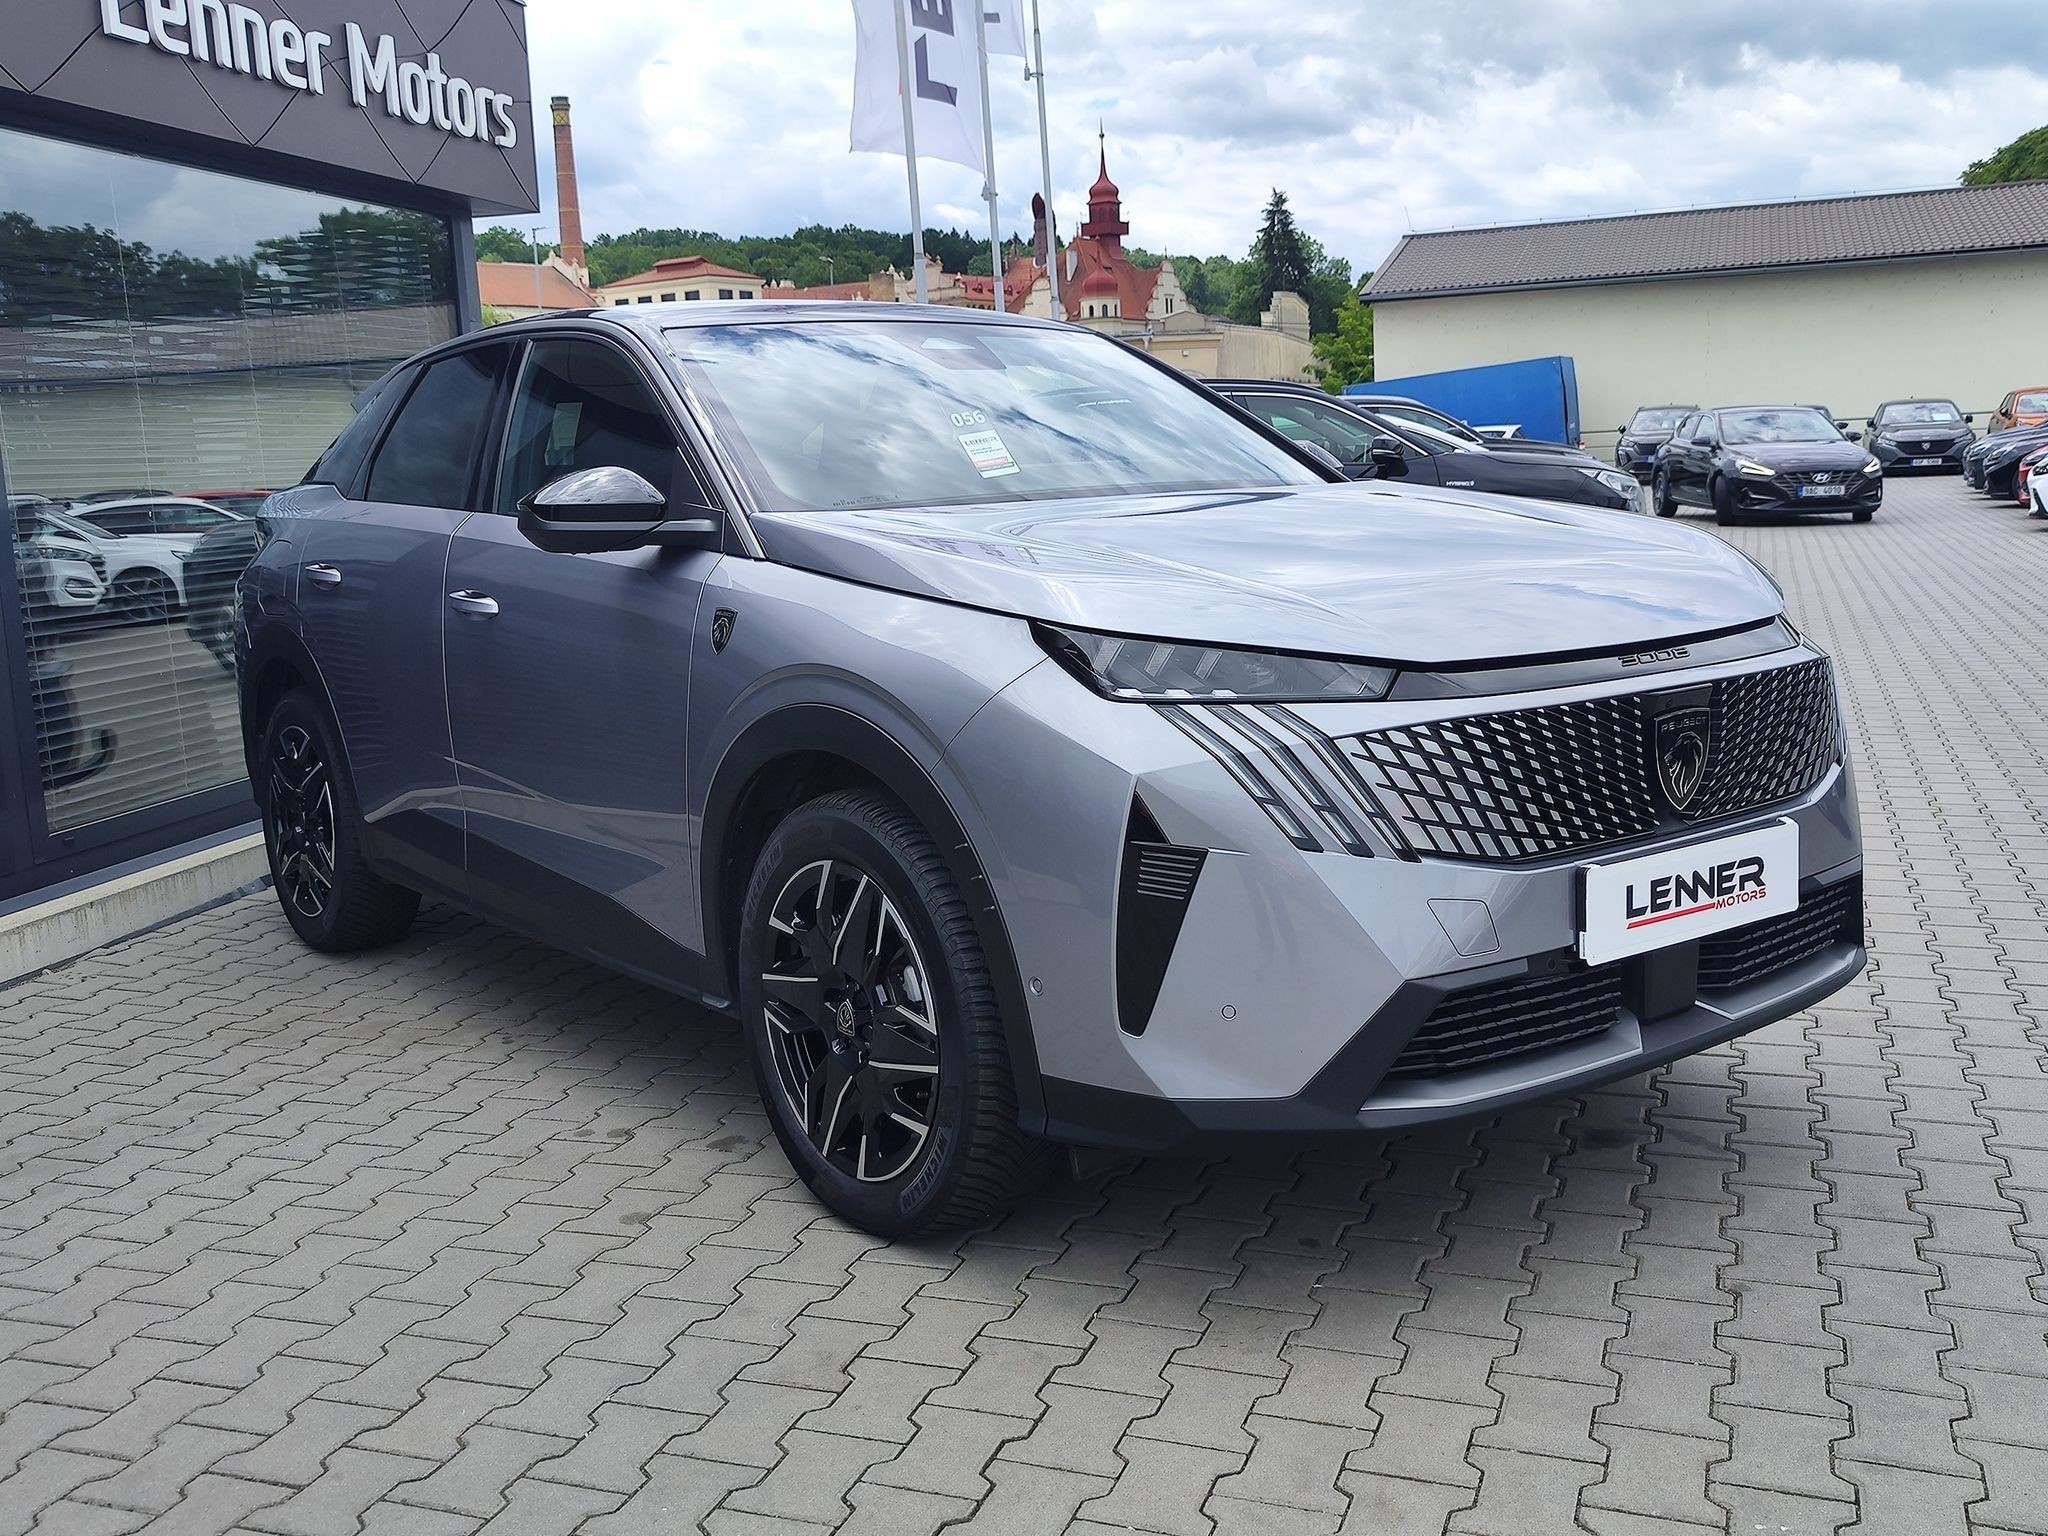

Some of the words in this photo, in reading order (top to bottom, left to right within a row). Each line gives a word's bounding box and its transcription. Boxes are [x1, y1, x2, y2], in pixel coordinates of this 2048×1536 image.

[345, 22, 517, 148] Motors
[951, 409, 985, 427] 056
[1618, 647, 1690, 667] 3008
[1661, 716, 1707, 732] PEUGEOT
[1626, 856, 1766, 919] LENNER
[1715, 887, 1767, 910] MOTORS
